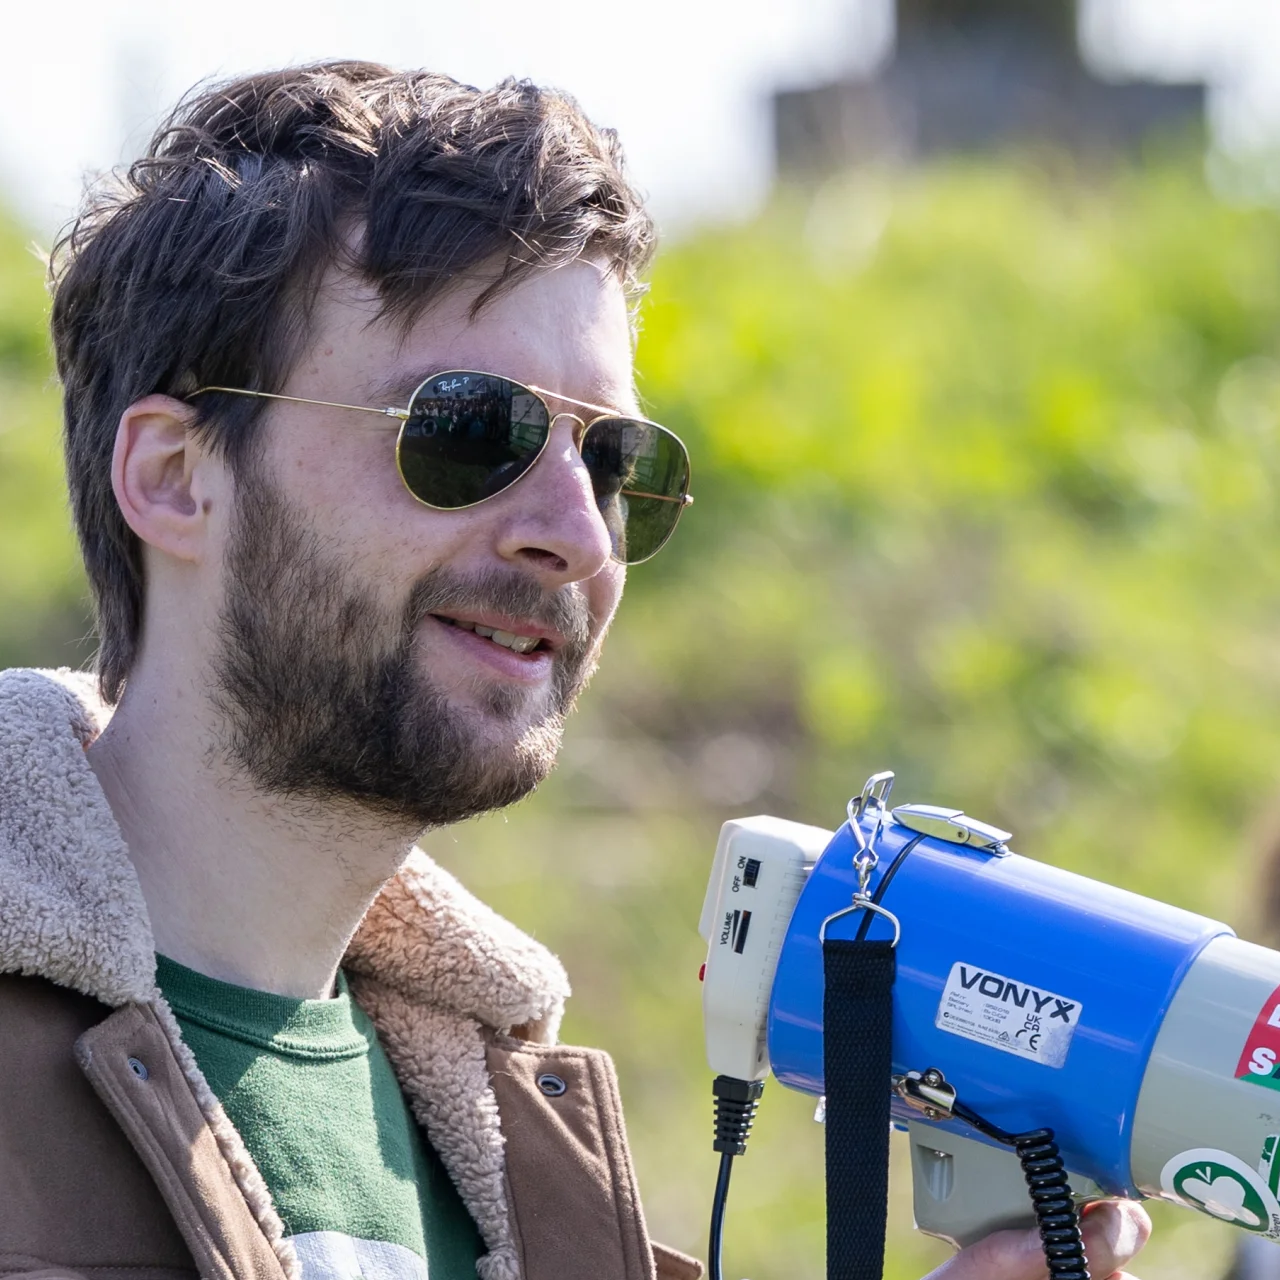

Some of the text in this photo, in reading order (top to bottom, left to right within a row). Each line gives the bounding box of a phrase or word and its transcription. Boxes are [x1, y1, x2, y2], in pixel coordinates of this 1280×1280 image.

[737, 855, 747, 869] ON
[732, 875, 741, 893] OFF
[720, 912, 734, 945] VOLUME
[960, 966, 1075, 1023] VONYX
[1023, 1021, 1040, 1032] CA
[1026, 1013, 1042, 1025] UK
